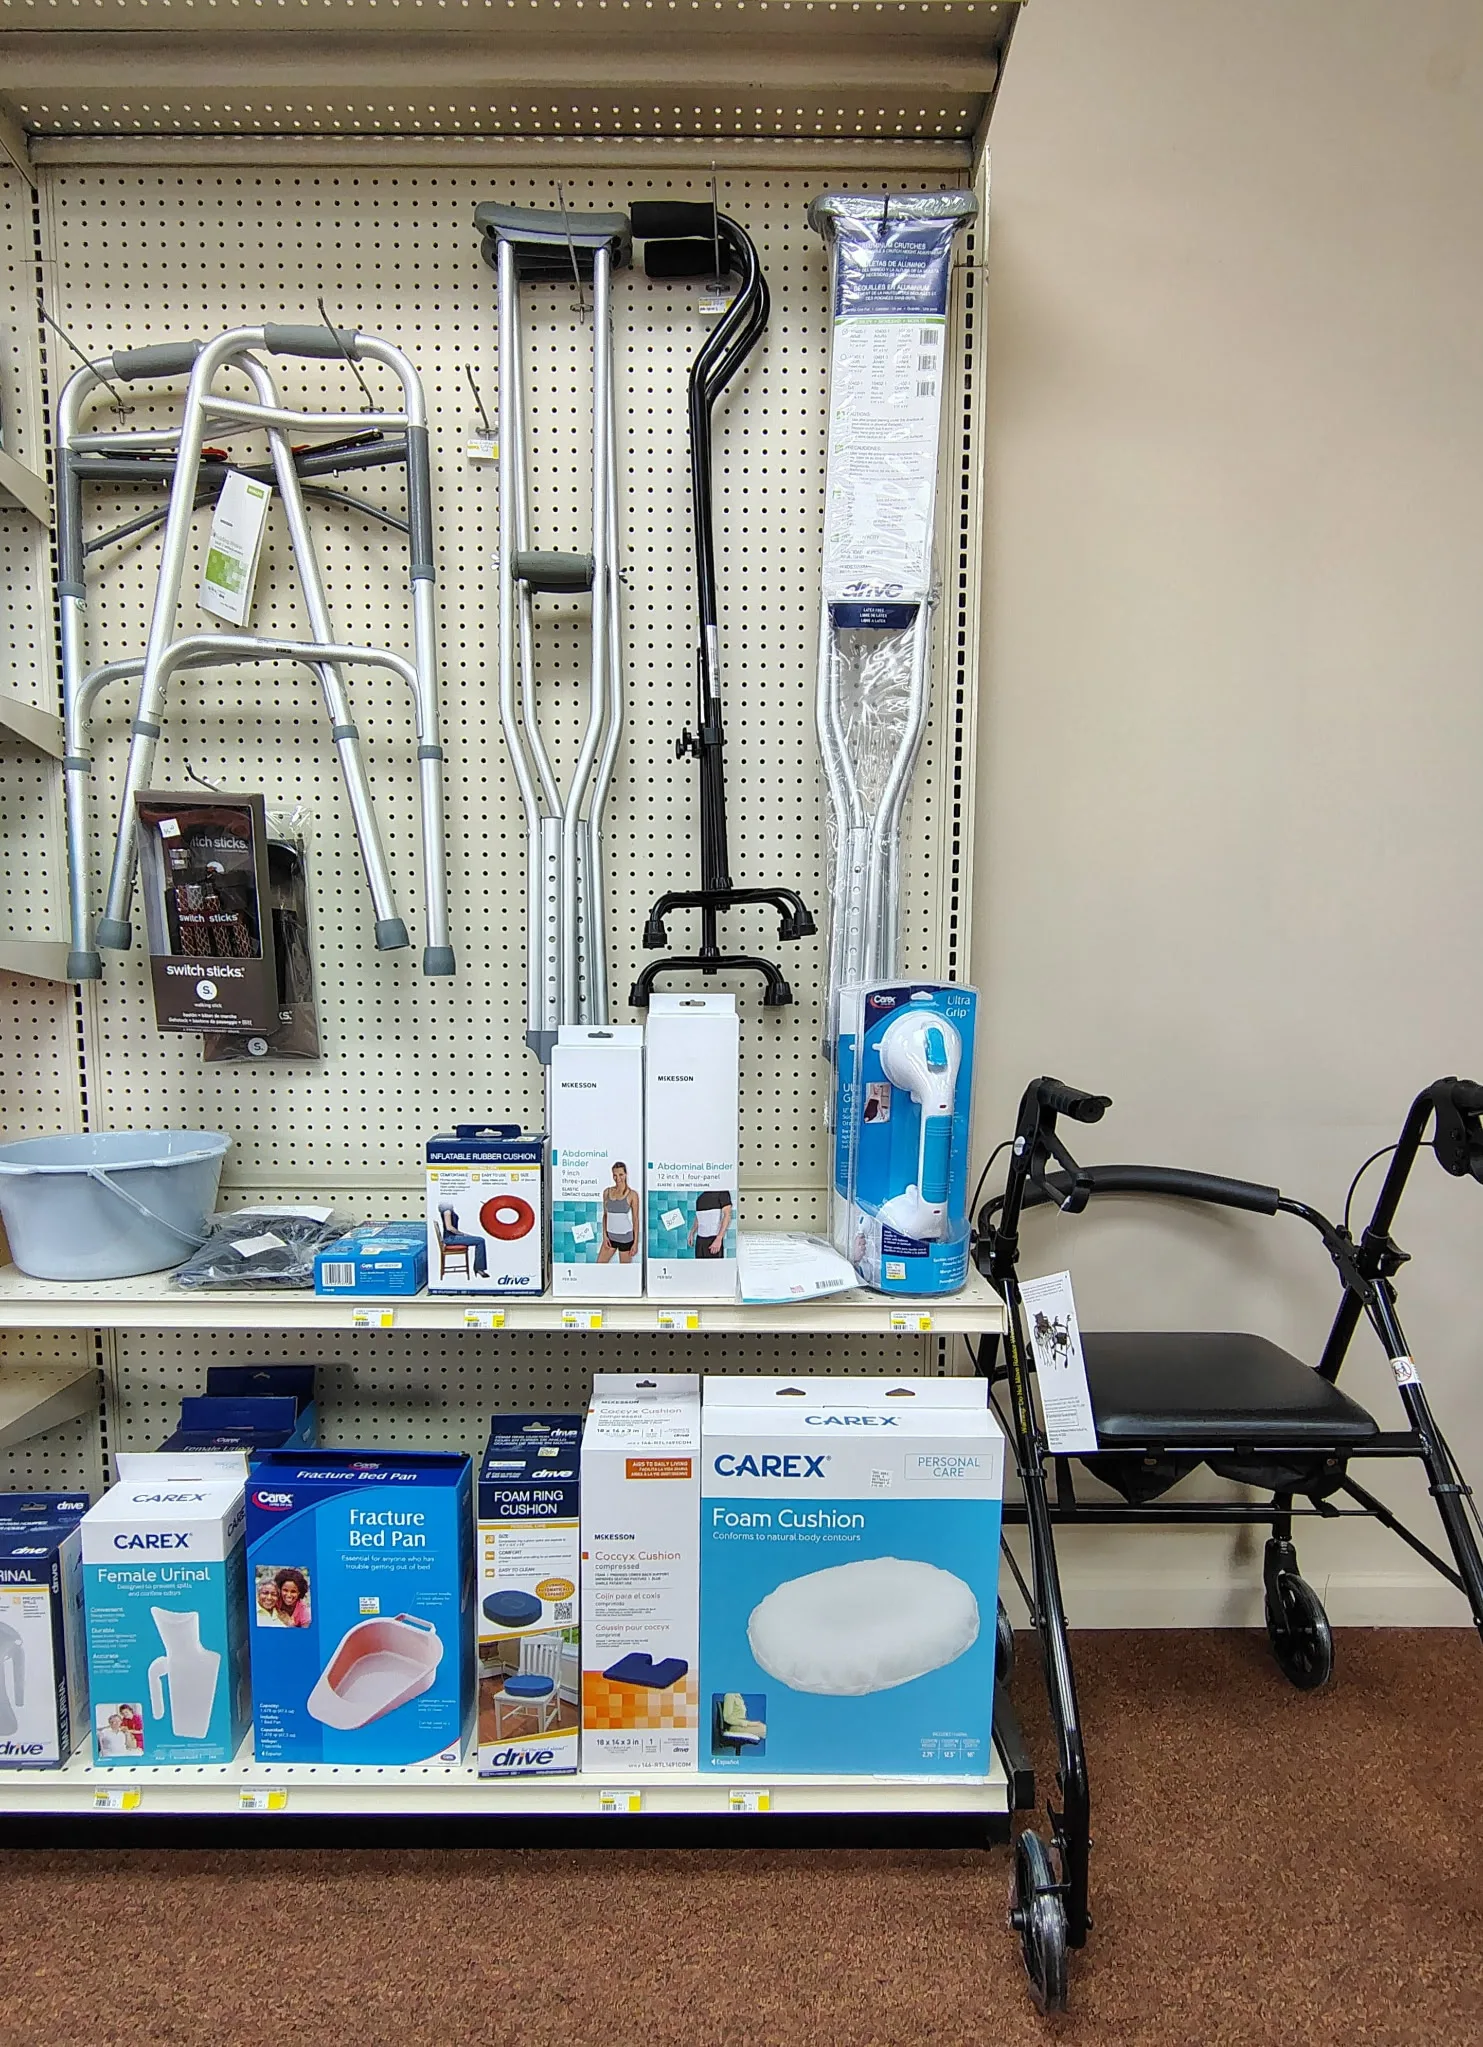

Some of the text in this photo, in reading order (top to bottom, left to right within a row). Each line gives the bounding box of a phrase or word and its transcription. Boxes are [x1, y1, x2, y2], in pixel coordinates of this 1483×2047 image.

[894, 242, 926, 250] CRUTCHES
[898, 261, 926, 269] ALUMINIO
[842, 581, 904, 598] drive
[190, 836, 213, 848] itch
[178, 913, 205, 923] switch
[166, 964, 205, 977] switch
[873, 995, 897, 1004] Carex
[947, 995, 971, 1005] Ultra
[431, 1153, 536, 1161] INFLATABLE RUBBER CUSHION
[562, 1150, 608, 1158] Abdominal
[562, 1159, 589, 1167] Binder
[657, 1162, 733, 1171] Abdominal Binder
[562, 1178, 598, 1186] three-panel
[687, 1173, 721, 1181] four-panel
[498, 1275, 531, 1286] drive
[805, 1416, 898, 1426] CAREX
[551, 1429, 578, 1437] drive
[918, 1456, 980, 1468] PERSONAL
[297, 1471, 417, 1481] Fracture Bed Pan
[531, 1469, 574, 1478] drive
[933, 1467, 964, 1478] CARE
[132, 1493, 206, 1503] CAREX
[257, 1491, 294, 1504] Carex
[494, 1490, 564, 1502] FOAM RING
[57, 1501, 84, 1510] drive
[500, 1504, 557, 1515] CUSHION
[227, 1506, 246, 1537] CARE
[349, 1509, 425, 1526] Fracture
[713, 1508, 865, 1528] Foam Cushion
[349, 1530, 426, 1547] Bed Pan
[712, 1532, 861, 1543] Conforms to natural body contours
[12, 1546, 48, 1555] drive
[382, 1556, 406, 1564] anyone
[595, 1551, 681, 1562] Coccyx Cushion
[371, 1563, 394, 1572] getting
[595, 1563, 640, 1571] compressed
[0, 1569, 36, 1582] RINAL
[51, 1563, 59, 1594] drive
[98, 1567, 211, 1583] Female Urinal
[0, 1741, 43, 1756] drive
[492, 1749, 554, 1766] drive
